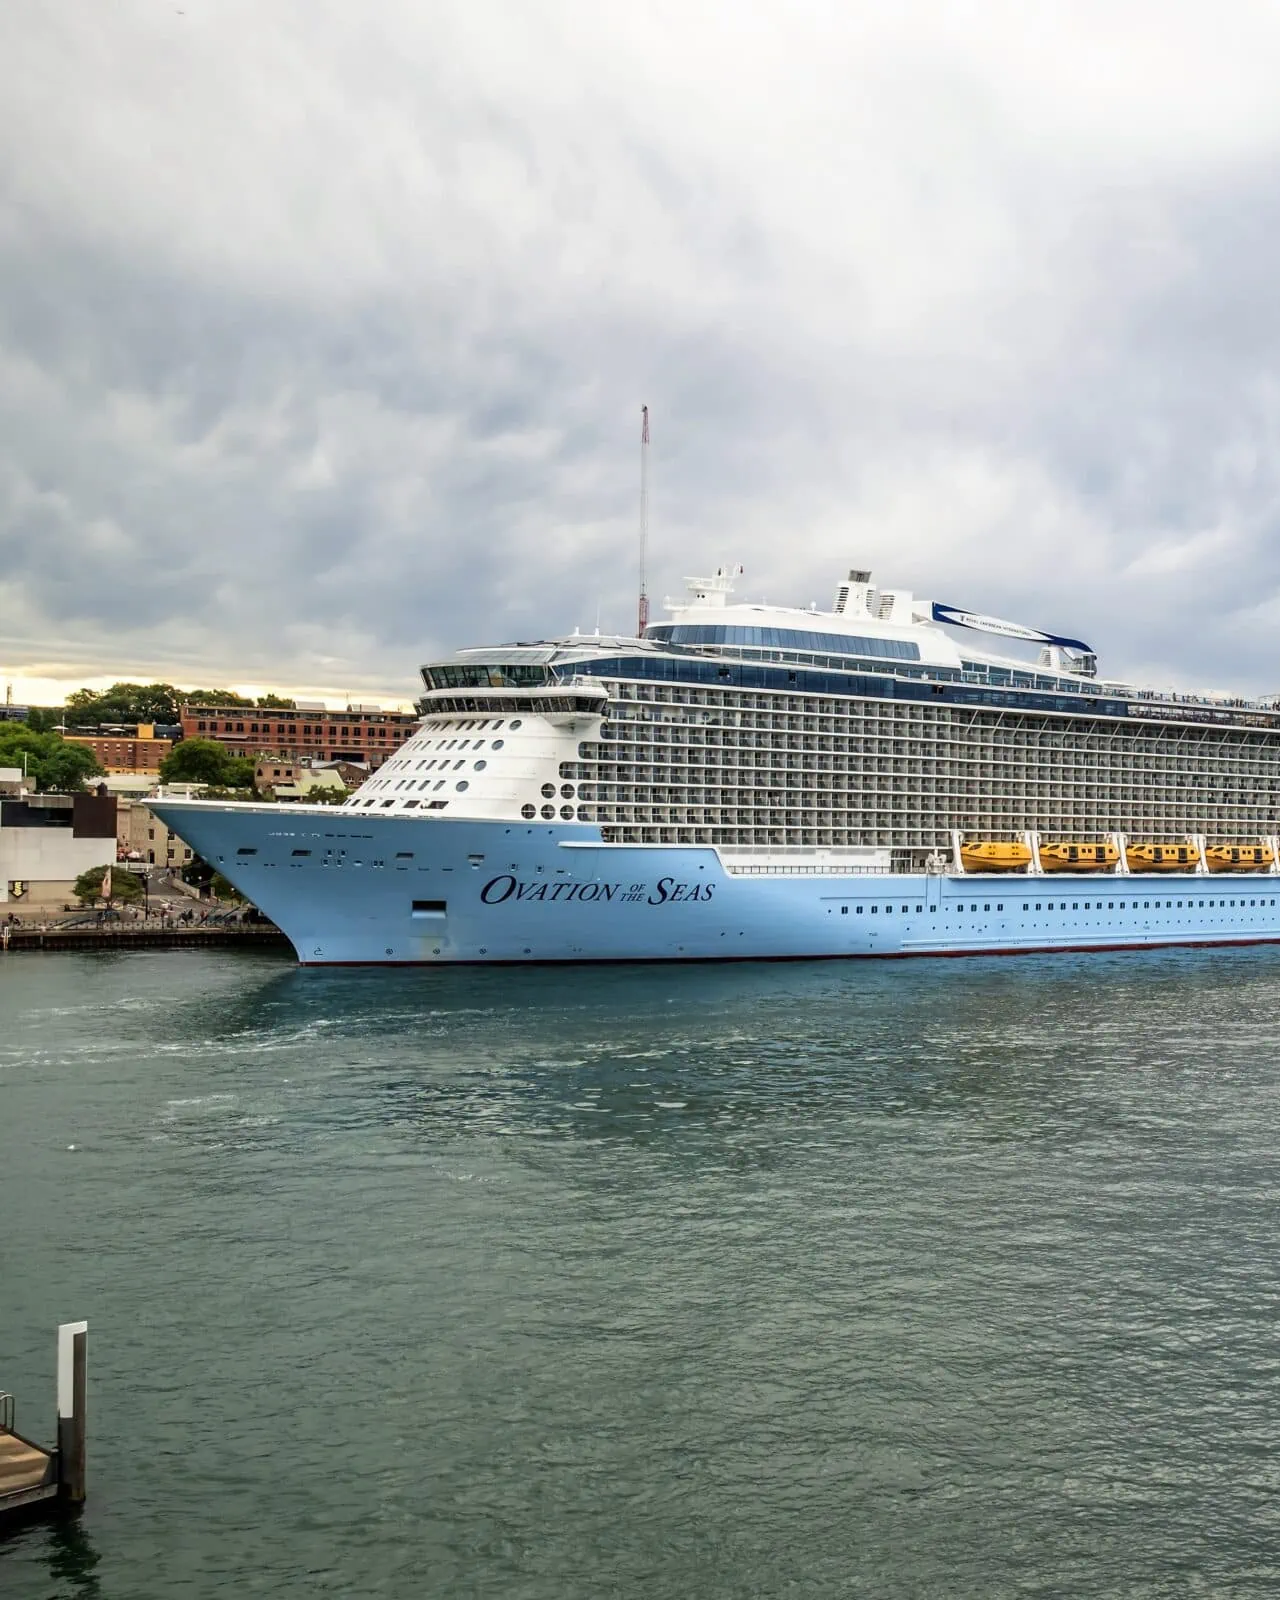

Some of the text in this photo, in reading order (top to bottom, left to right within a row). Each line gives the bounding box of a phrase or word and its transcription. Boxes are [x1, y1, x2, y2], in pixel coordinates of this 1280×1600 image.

[480, 875, 716, 905] OVATION OF THE SEAS
